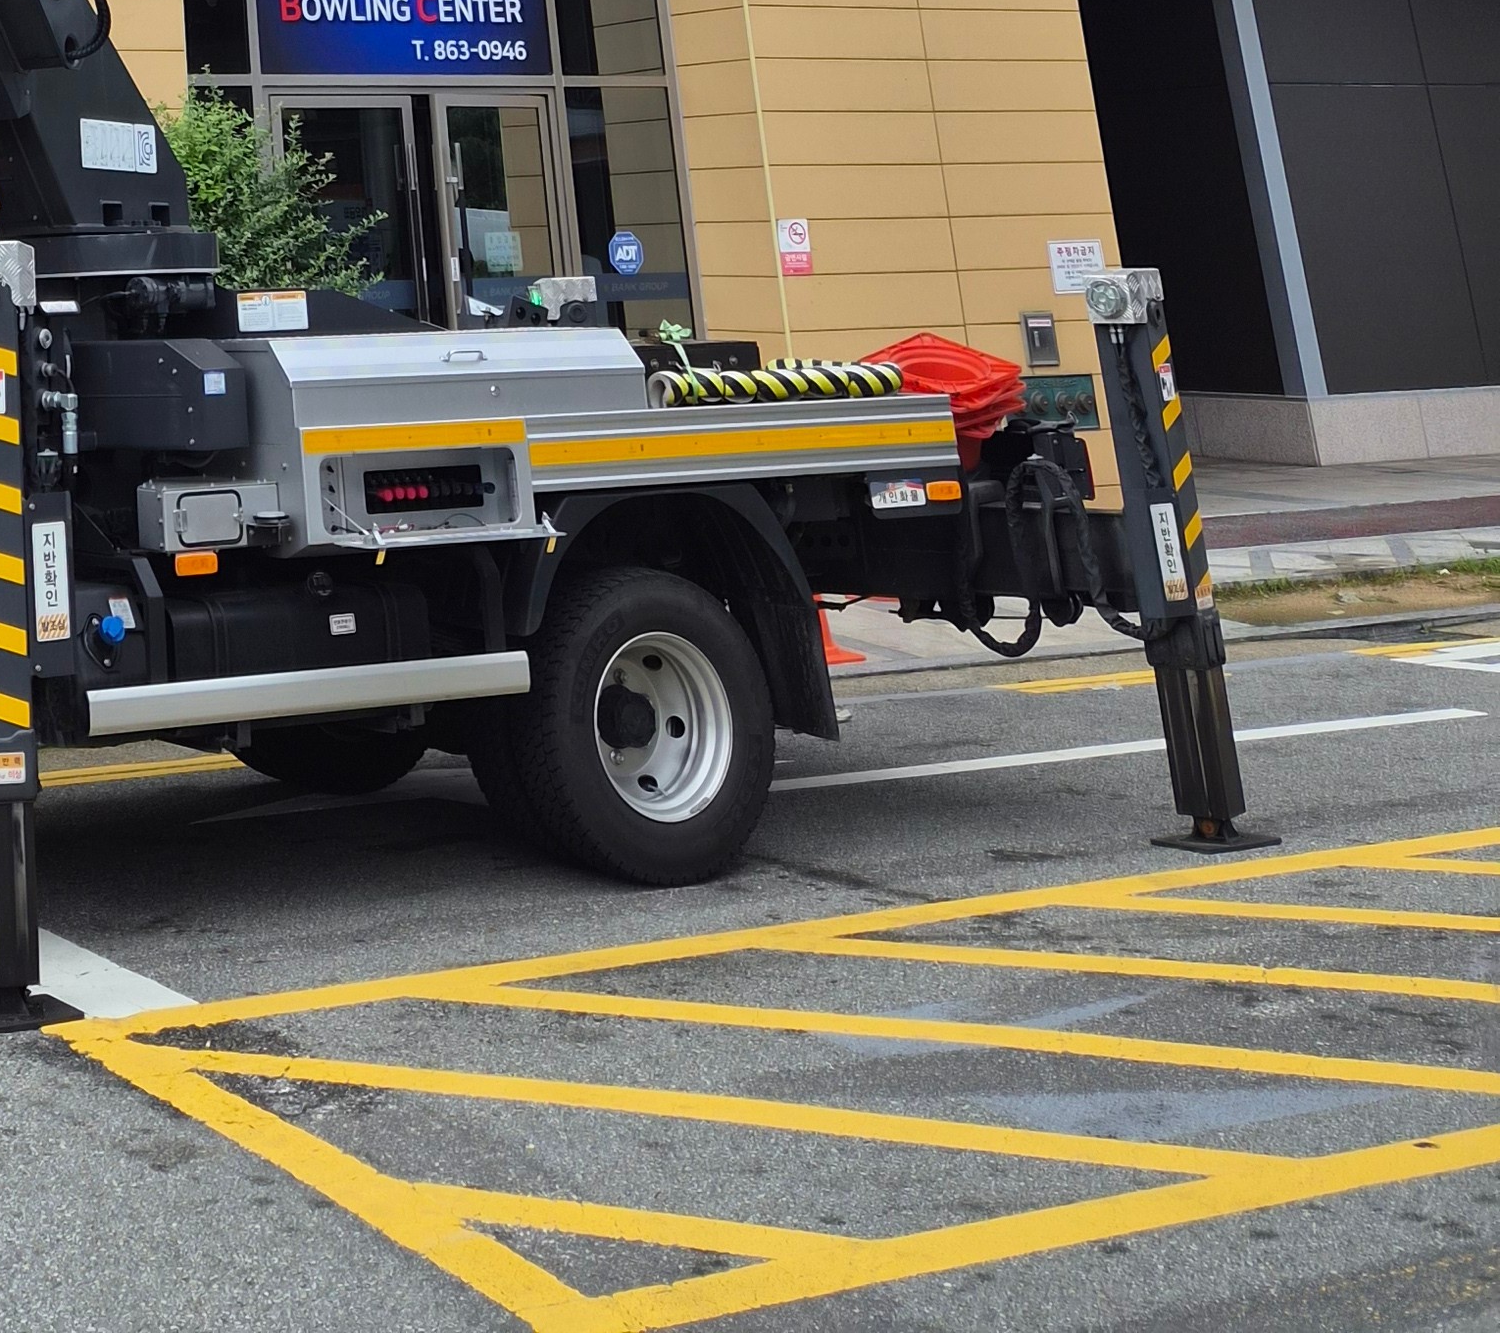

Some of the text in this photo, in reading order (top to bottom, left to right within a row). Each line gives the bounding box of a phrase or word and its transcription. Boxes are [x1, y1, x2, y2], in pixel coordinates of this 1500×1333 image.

[411, 39, 527, 61] T. 863-0946
[615, 245, 638, 261] ADT
[1056, 245, 1095, 257] 주정차금지
[878, 489, 919, 504] 개인화물
[1158, 511, 1177, 574] 지반확인
[43, 531, 59, 608] 지반확인
